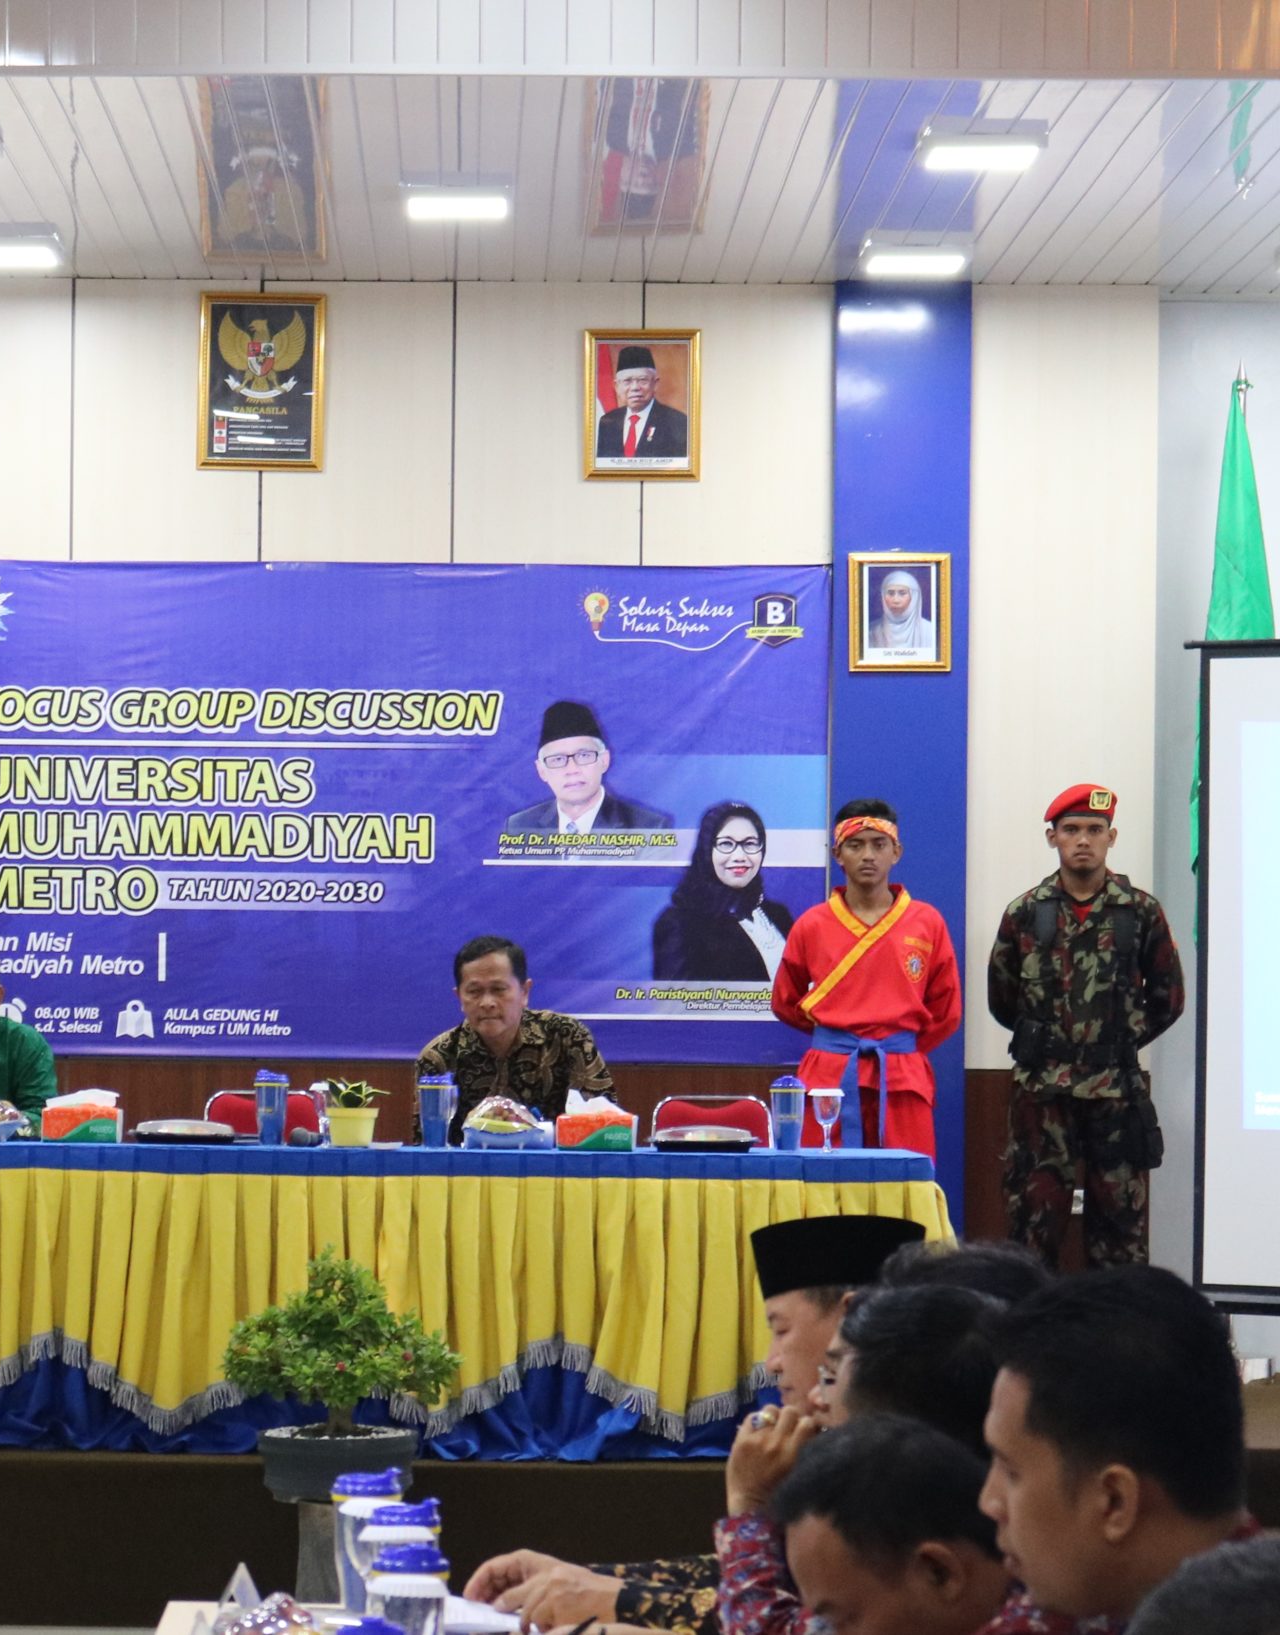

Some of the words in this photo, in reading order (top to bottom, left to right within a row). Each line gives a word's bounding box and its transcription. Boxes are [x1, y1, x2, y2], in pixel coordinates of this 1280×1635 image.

[618, 597, 673, 617] Solusi
[678, 597, 734, 618] Sukses
[766, 602, 786, 625] B
[622, 615, 662, 632] Masa
[665, 616, 710, 638] Depan
[109, 690, 256, 728] GROUP
[259, 691, 500, 731] DISCUSSION
[498, 833, 525, 845] Prof.
[528, 834, 545, 845] Dr.
[548, 834, 597, 846] HAEDAR
[600, 834, 646, 847] NASHIR,
[498, 847, 523, 855] Ketua
[524, 847, 553, 855] Umum
[567, 847, 635, 857] Muhammadiyah
[168, 879, 252, 902] TAHUN
[255, 881, 384, 903] 2020-2030
[26, 932, 73, 952] Misi
[80, 955, 144, 976] Metro
[615, 988, 632, 999] Dr.
[635, 988, 646, 999] Ir.
[649, 988, 713, 1002] Paristiyanti
[34, 1007, 71, 1019] 08.00
[73, 1007, 100, 1020] WIB
[687, 1002, 721, 1010] Direktur
[163, 1008, 199, 1020] AULA
[203, 1009, 261, 1022] GEDUNG
[58, 1020, 103, 1034] Selesai
[163, 1022, 216, 1037] Kampus
[226, 1023, 250, 1035] UM
[252, 1023, 291, 1036] Metro
